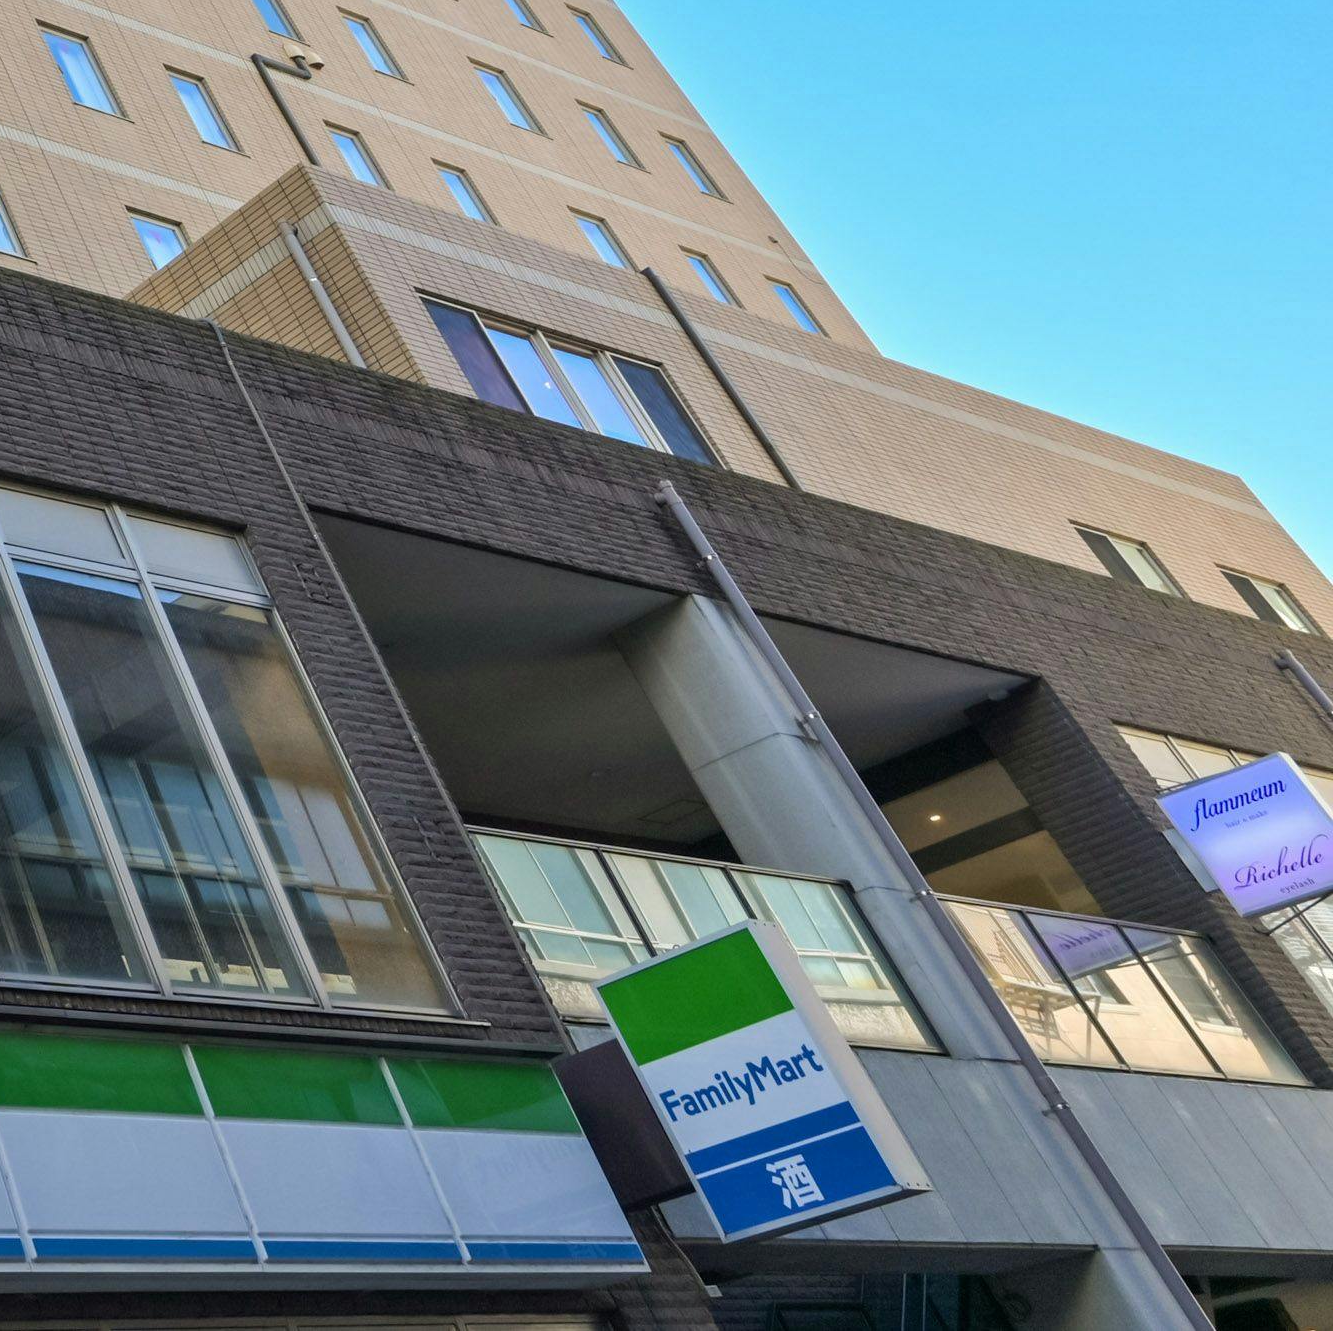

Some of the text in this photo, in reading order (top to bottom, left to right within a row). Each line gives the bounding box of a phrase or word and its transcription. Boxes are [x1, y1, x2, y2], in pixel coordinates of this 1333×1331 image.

[1190, 779, 1287, 832] flammeum
[1234, 833, 1329, 890] Richelle
[1280, 878, 1316, 895] eyelash
[659, 1044, 824, 1122] FamilyMart
[765, 1154, 825, 1210] 酒
